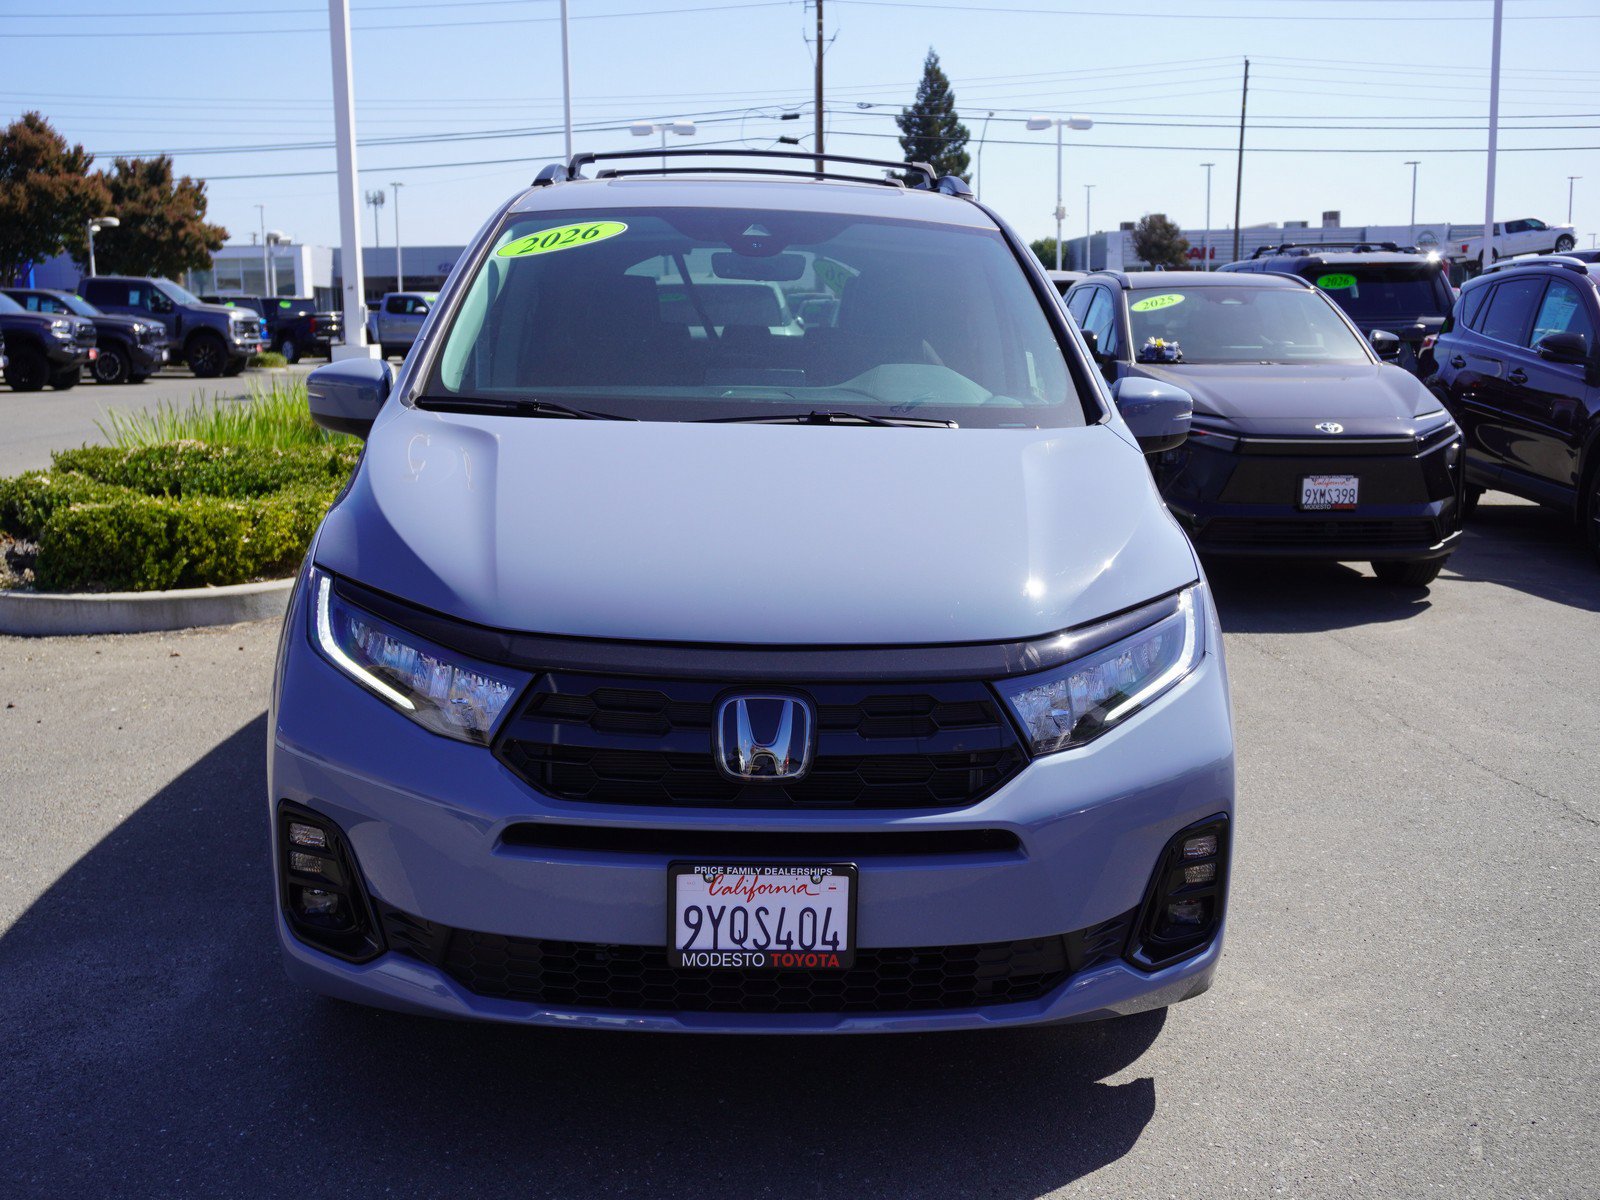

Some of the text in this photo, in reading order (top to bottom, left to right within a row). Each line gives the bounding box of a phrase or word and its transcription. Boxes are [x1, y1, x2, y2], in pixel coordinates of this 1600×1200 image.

[516, 223, 604, 255] 2026
[1142, 295, 1174, 310] 2025
[1304, 488, 1356, 505] 9XMS398
[694, 866, 833, 877] PRICE FAMILY DEALERSHIPS
[708, 873, 820, 903] California
[682, 904, 840, 951] 9YQS404
[682, 952, 840, 968] MODESTO TOYOTA
